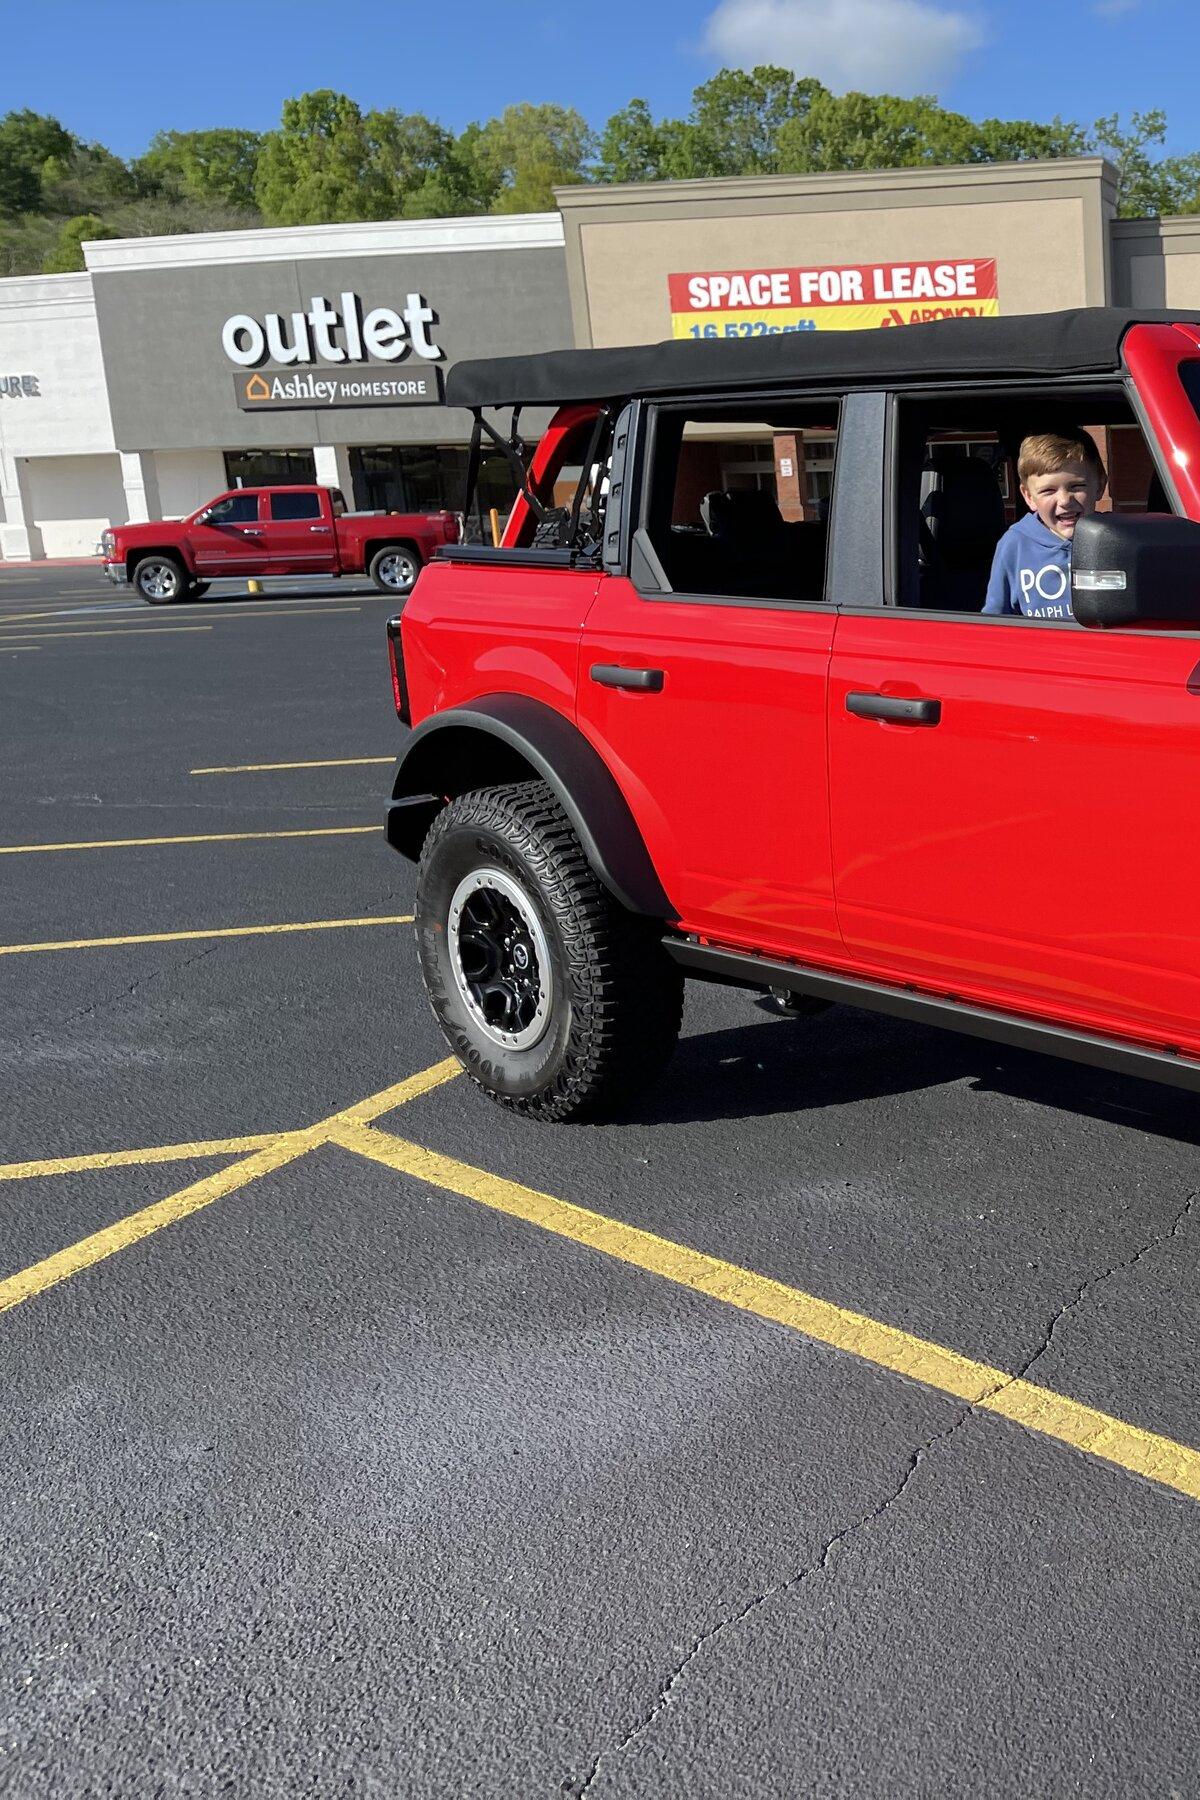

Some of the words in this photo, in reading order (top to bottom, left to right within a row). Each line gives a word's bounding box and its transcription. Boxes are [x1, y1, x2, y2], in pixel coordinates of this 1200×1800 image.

[688, 272, 791, 308] SPACE
[800, 270, 864, 304] FOR
[873, 264, 977, 300] LEASE
[222, 292, 441, 366] outlet
[271, 374, 338, 404] Ashley
[340, 380, 427, 397] HOMESTORE
[1020, 563, 1071, 604] PO
